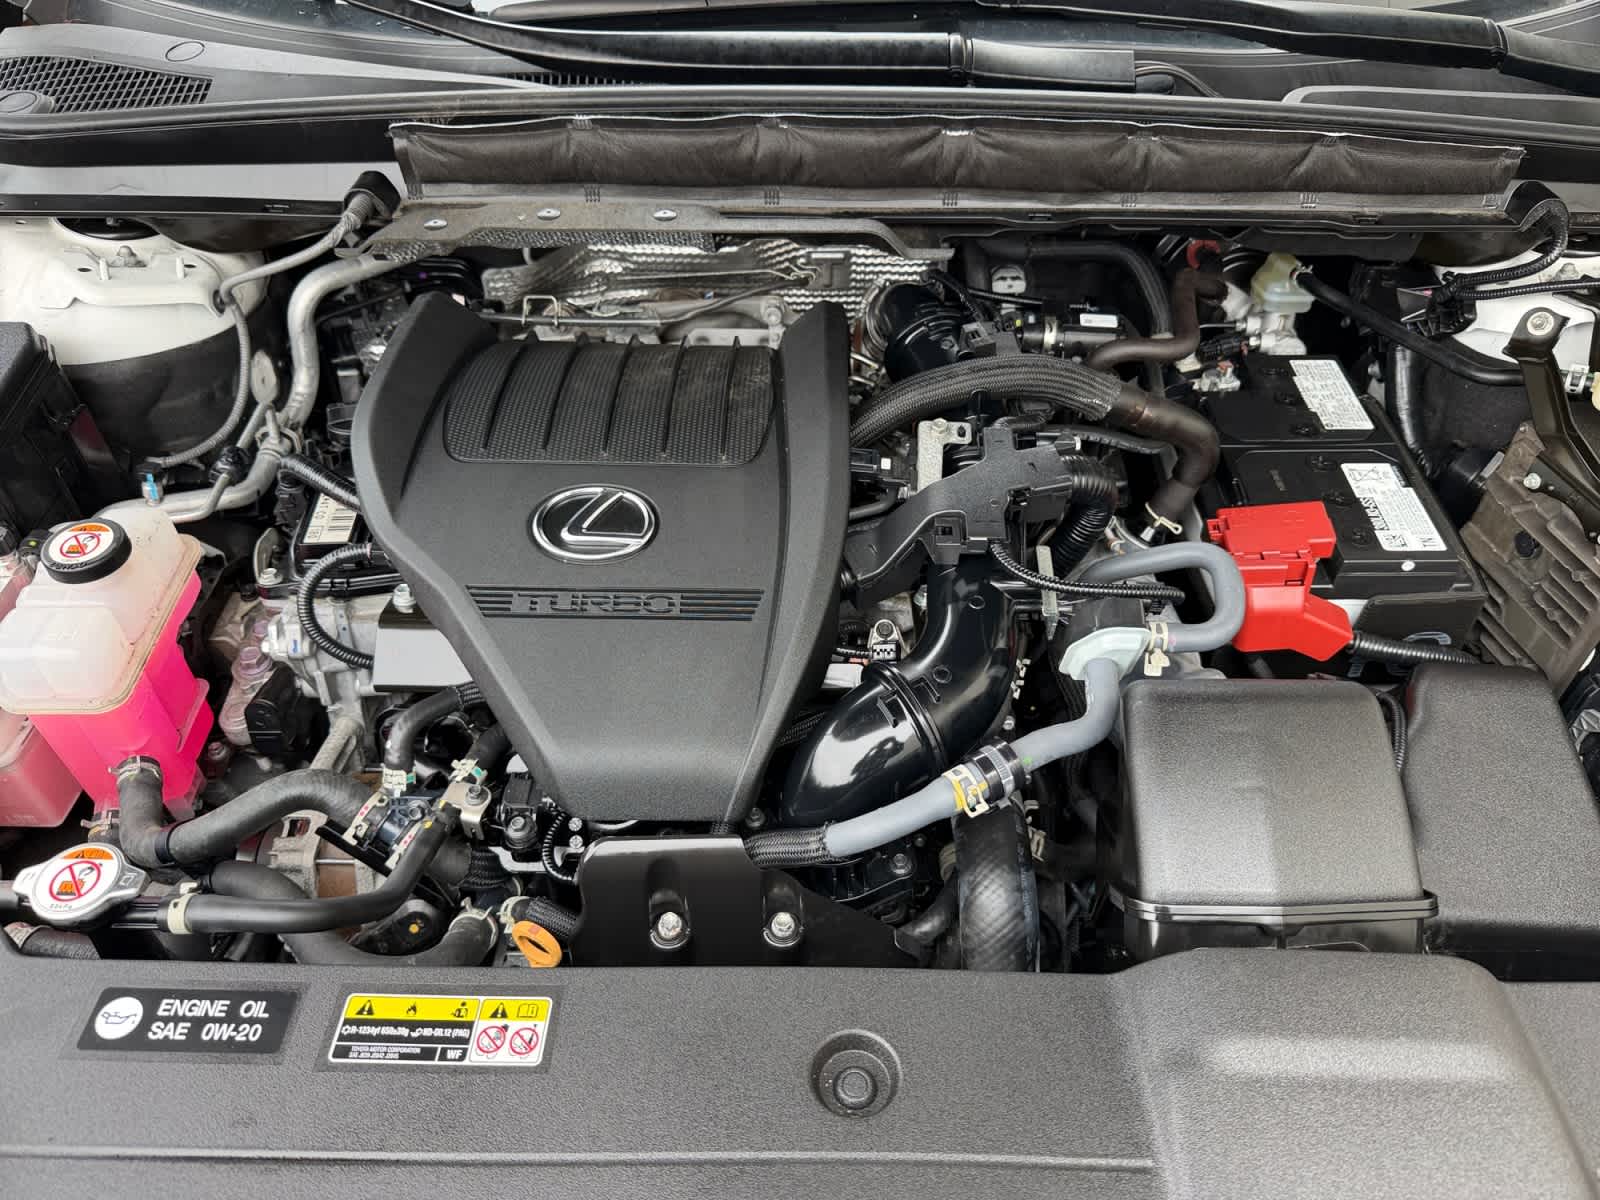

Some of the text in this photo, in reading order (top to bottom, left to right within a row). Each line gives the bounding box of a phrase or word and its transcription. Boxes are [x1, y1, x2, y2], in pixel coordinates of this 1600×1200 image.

[516, 592, 676, 614] TURBO
[157, 998, 269, 1018] ENGINE OIL
[147, 1021, 263, 1042] SAE 0W-20
[447, 1049, 463, 1060] WF
